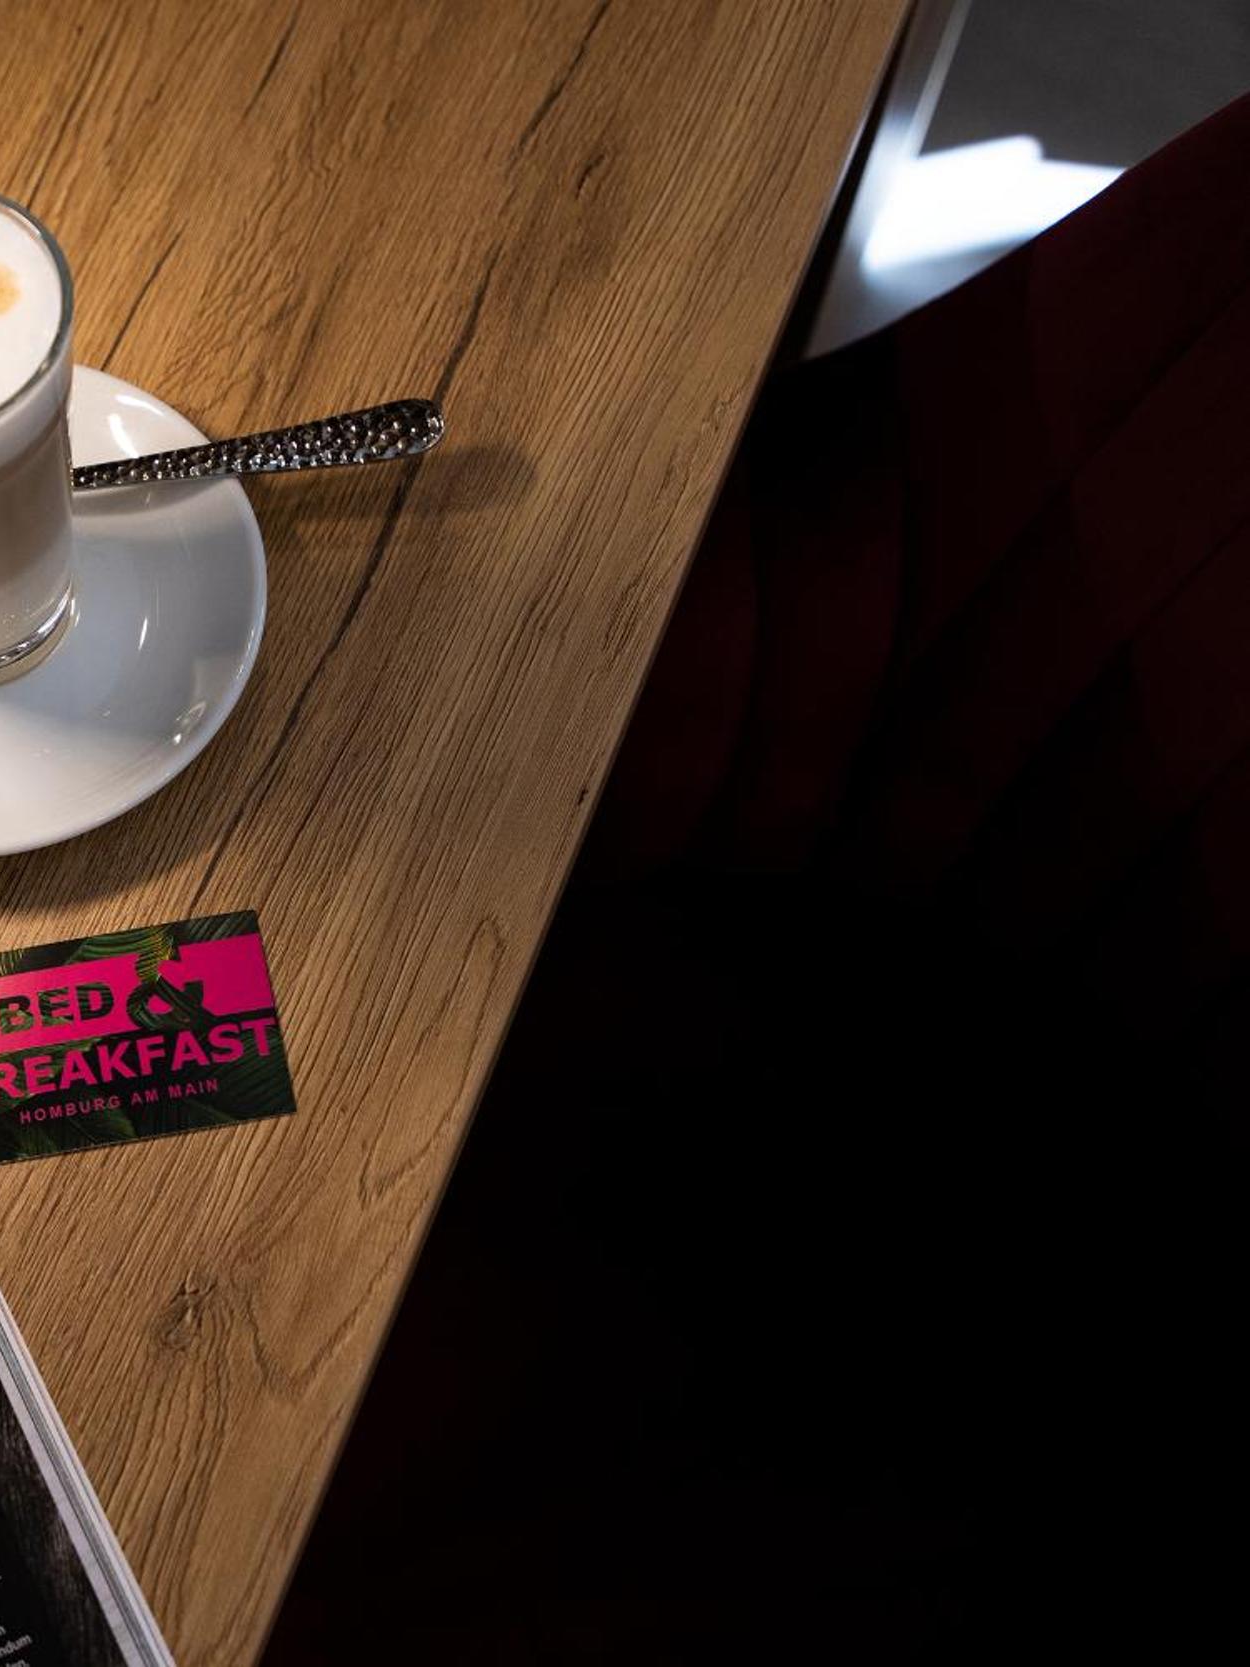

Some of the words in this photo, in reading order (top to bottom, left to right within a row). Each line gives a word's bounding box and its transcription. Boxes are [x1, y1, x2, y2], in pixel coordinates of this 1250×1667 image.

[126, 941, 215, 1031] &
[19, 1096, 122, 1125] HOMBURG
[129, 1089, 159, 1106] AM
[169, 1079, 219, 1098] MAIN
